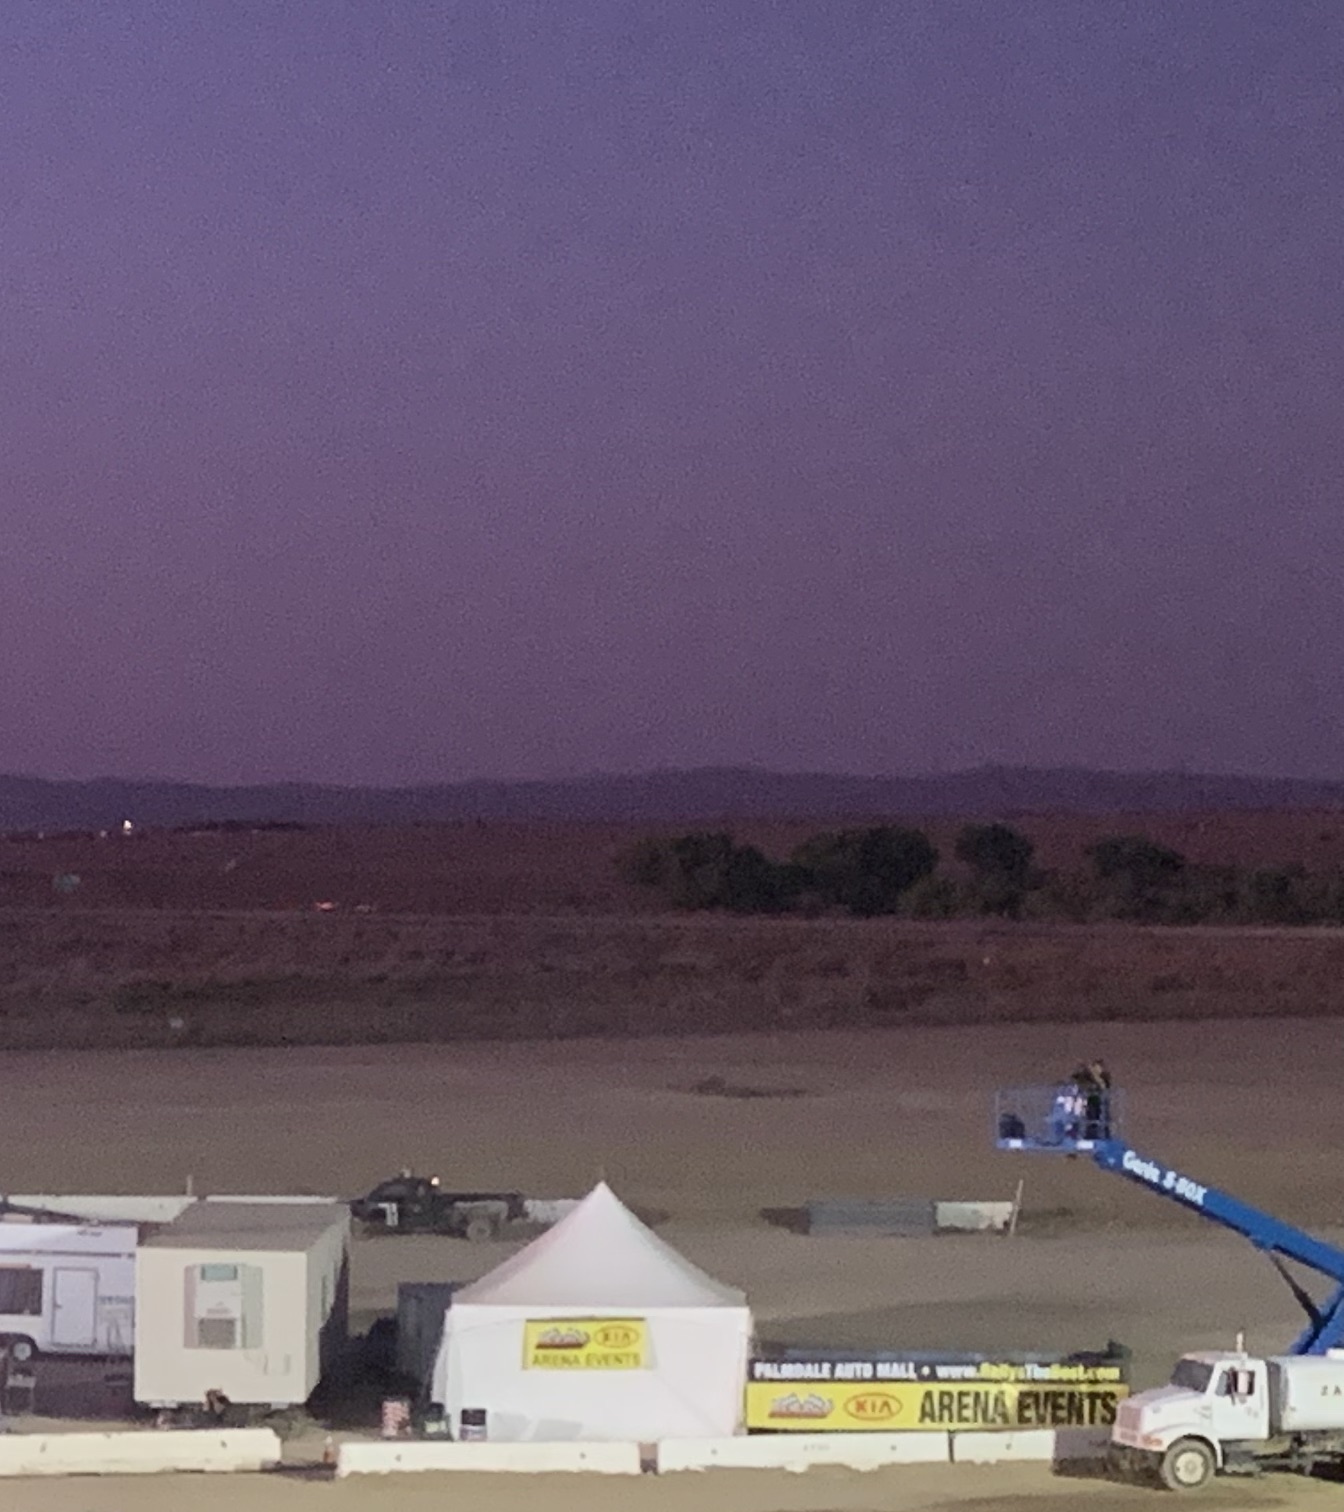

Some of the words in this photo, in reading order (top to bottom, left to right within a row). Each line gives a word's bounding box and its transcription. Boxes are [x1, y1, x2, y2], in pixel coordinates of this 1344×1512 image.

[532, 1353, 581, 1366] ARENA
[585, 1353, 641, 1366] EVENTS
[754, 1362, 832, 1378] PALMDALE
[834, 1362, 874, 1378] AUTO
[876, 1362, 918, 1379] MALL
[854, 1400, 894, 1413] KIA
[919, 1390, 1010, 1424] ARENA
[1017, 1390, 1117, 1425] EVENTS
